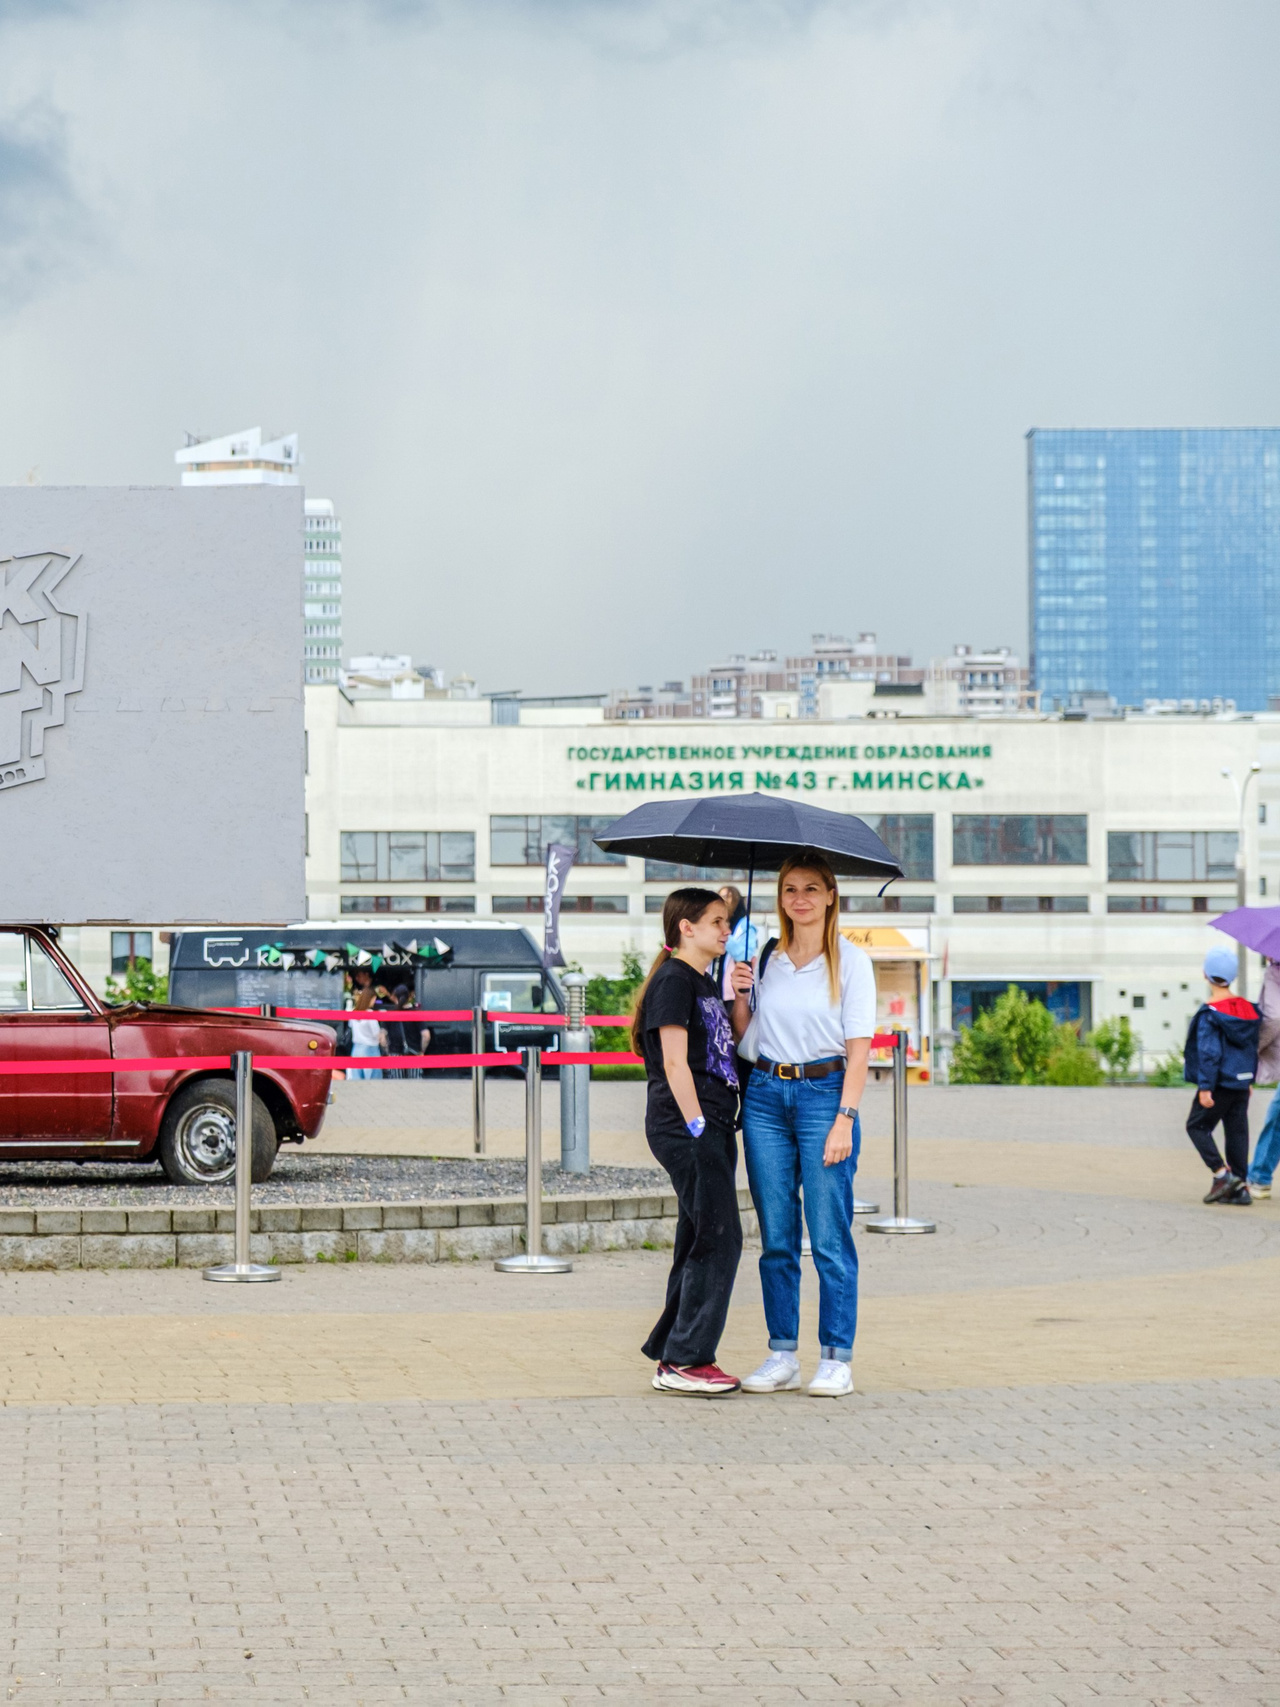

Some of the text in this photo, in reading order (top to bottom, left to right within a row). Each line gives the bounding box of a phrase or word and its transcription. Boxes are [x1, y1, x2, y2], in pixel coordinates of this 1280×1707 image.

[568, 744, 992, 763] ГОСУДАРСТВЕННОЕ УЧРЕЖДЕНИЕ ОБРАЗОВАНИЯ
[576, 771, 744, 791] «ГИМНАЗИЯ
